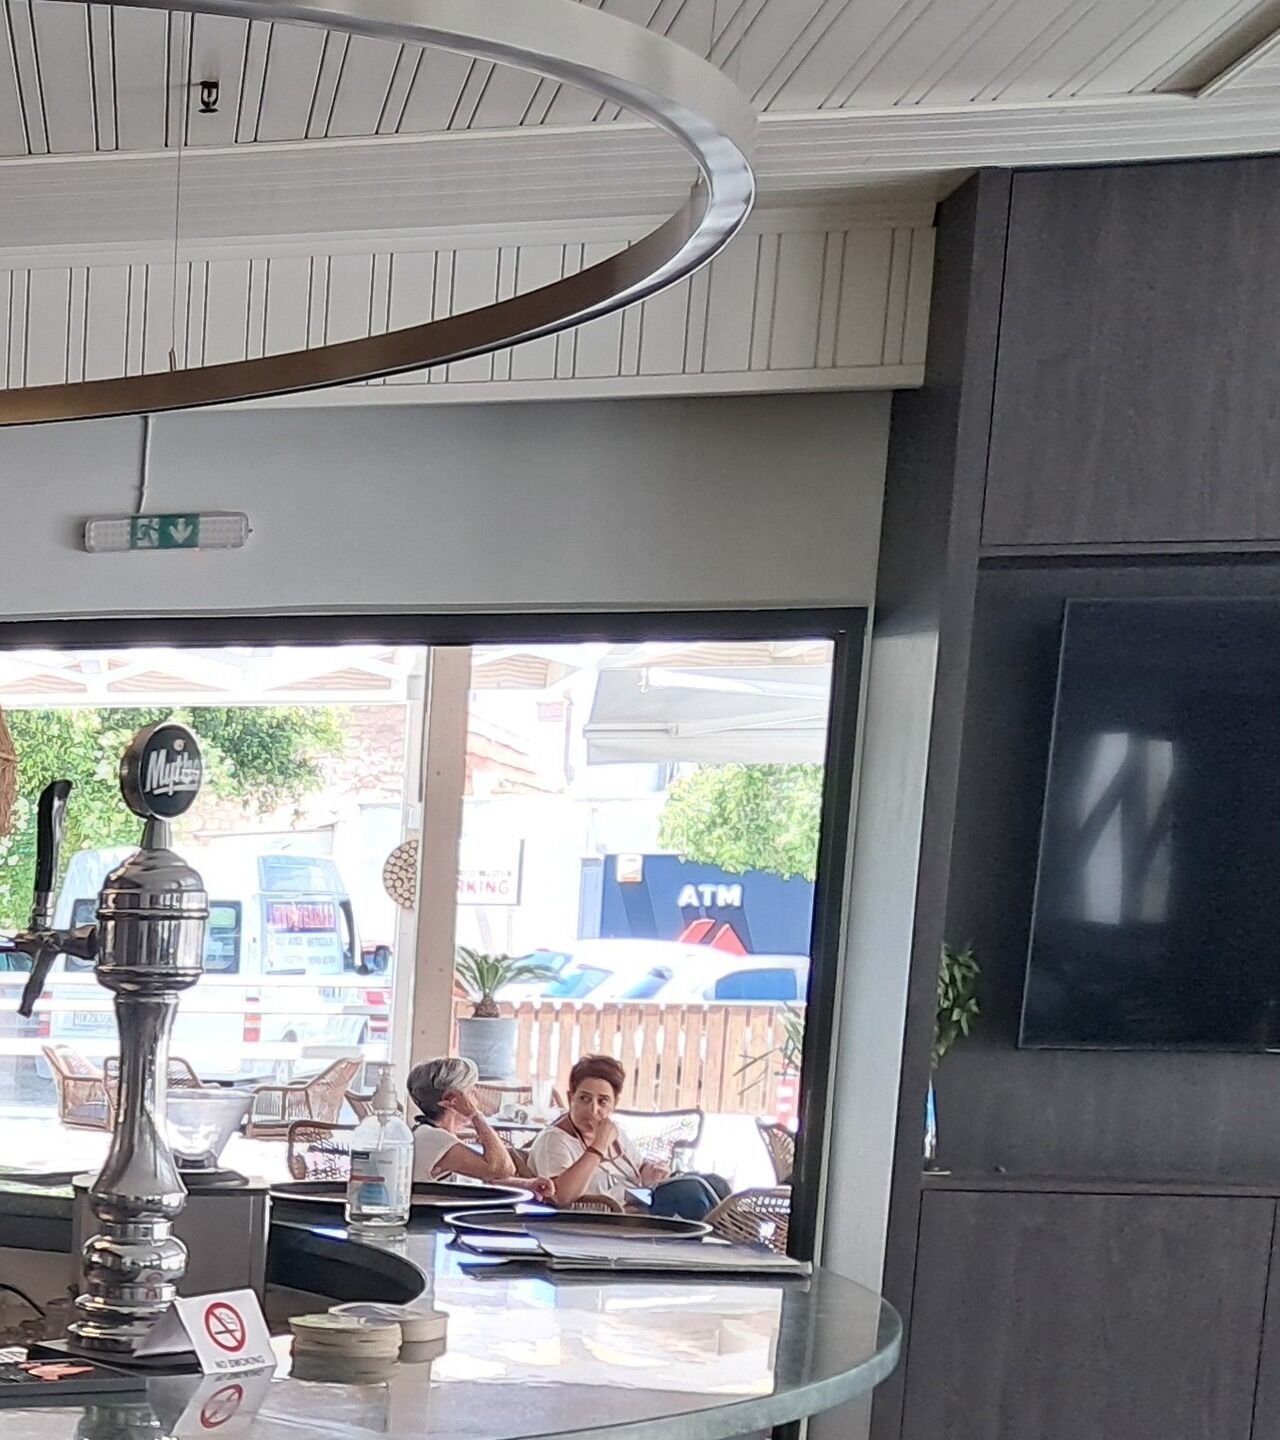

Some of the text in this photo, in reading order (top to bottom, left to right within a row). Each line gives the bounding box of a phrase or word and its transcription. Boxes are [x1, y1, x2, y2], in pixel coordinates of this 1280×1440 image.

[677, 883, 743, 908] ATM
[214, 1355, 266, 1369] NO SMOKING
